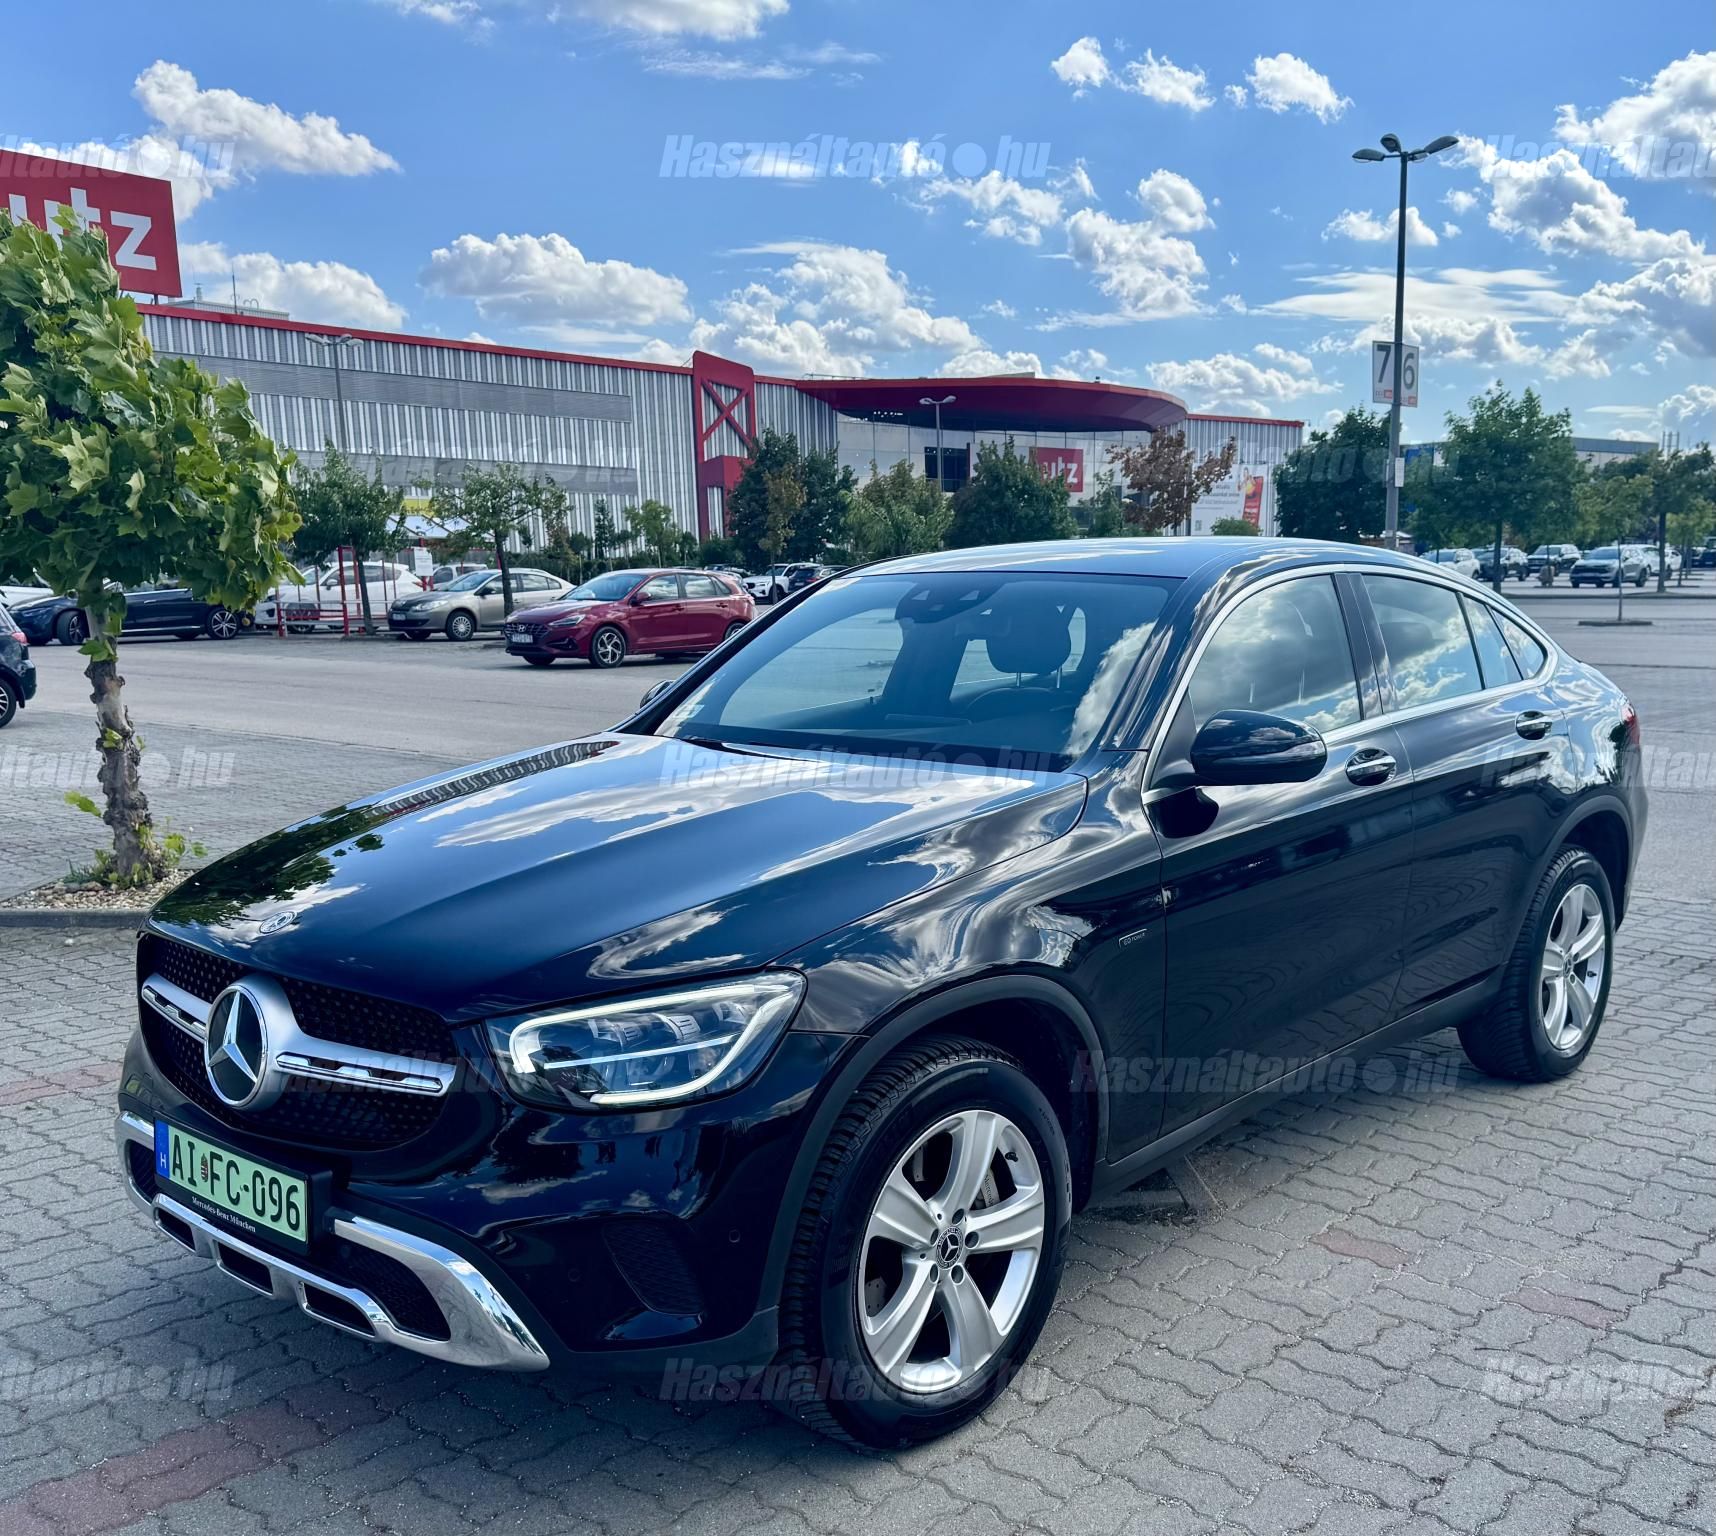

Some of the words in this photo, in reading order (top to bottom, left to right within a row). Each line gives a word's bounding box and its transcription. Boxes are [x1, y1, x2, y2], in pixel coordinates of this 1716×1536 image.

[1377, 344, 1391, 383] 7
[1403, 352, 1415, 390] 6
[159, 1152, 167, 1169] H
[172, 1134, 198, 1187] AI
[209, 1150, 301, 1232] FC-096
